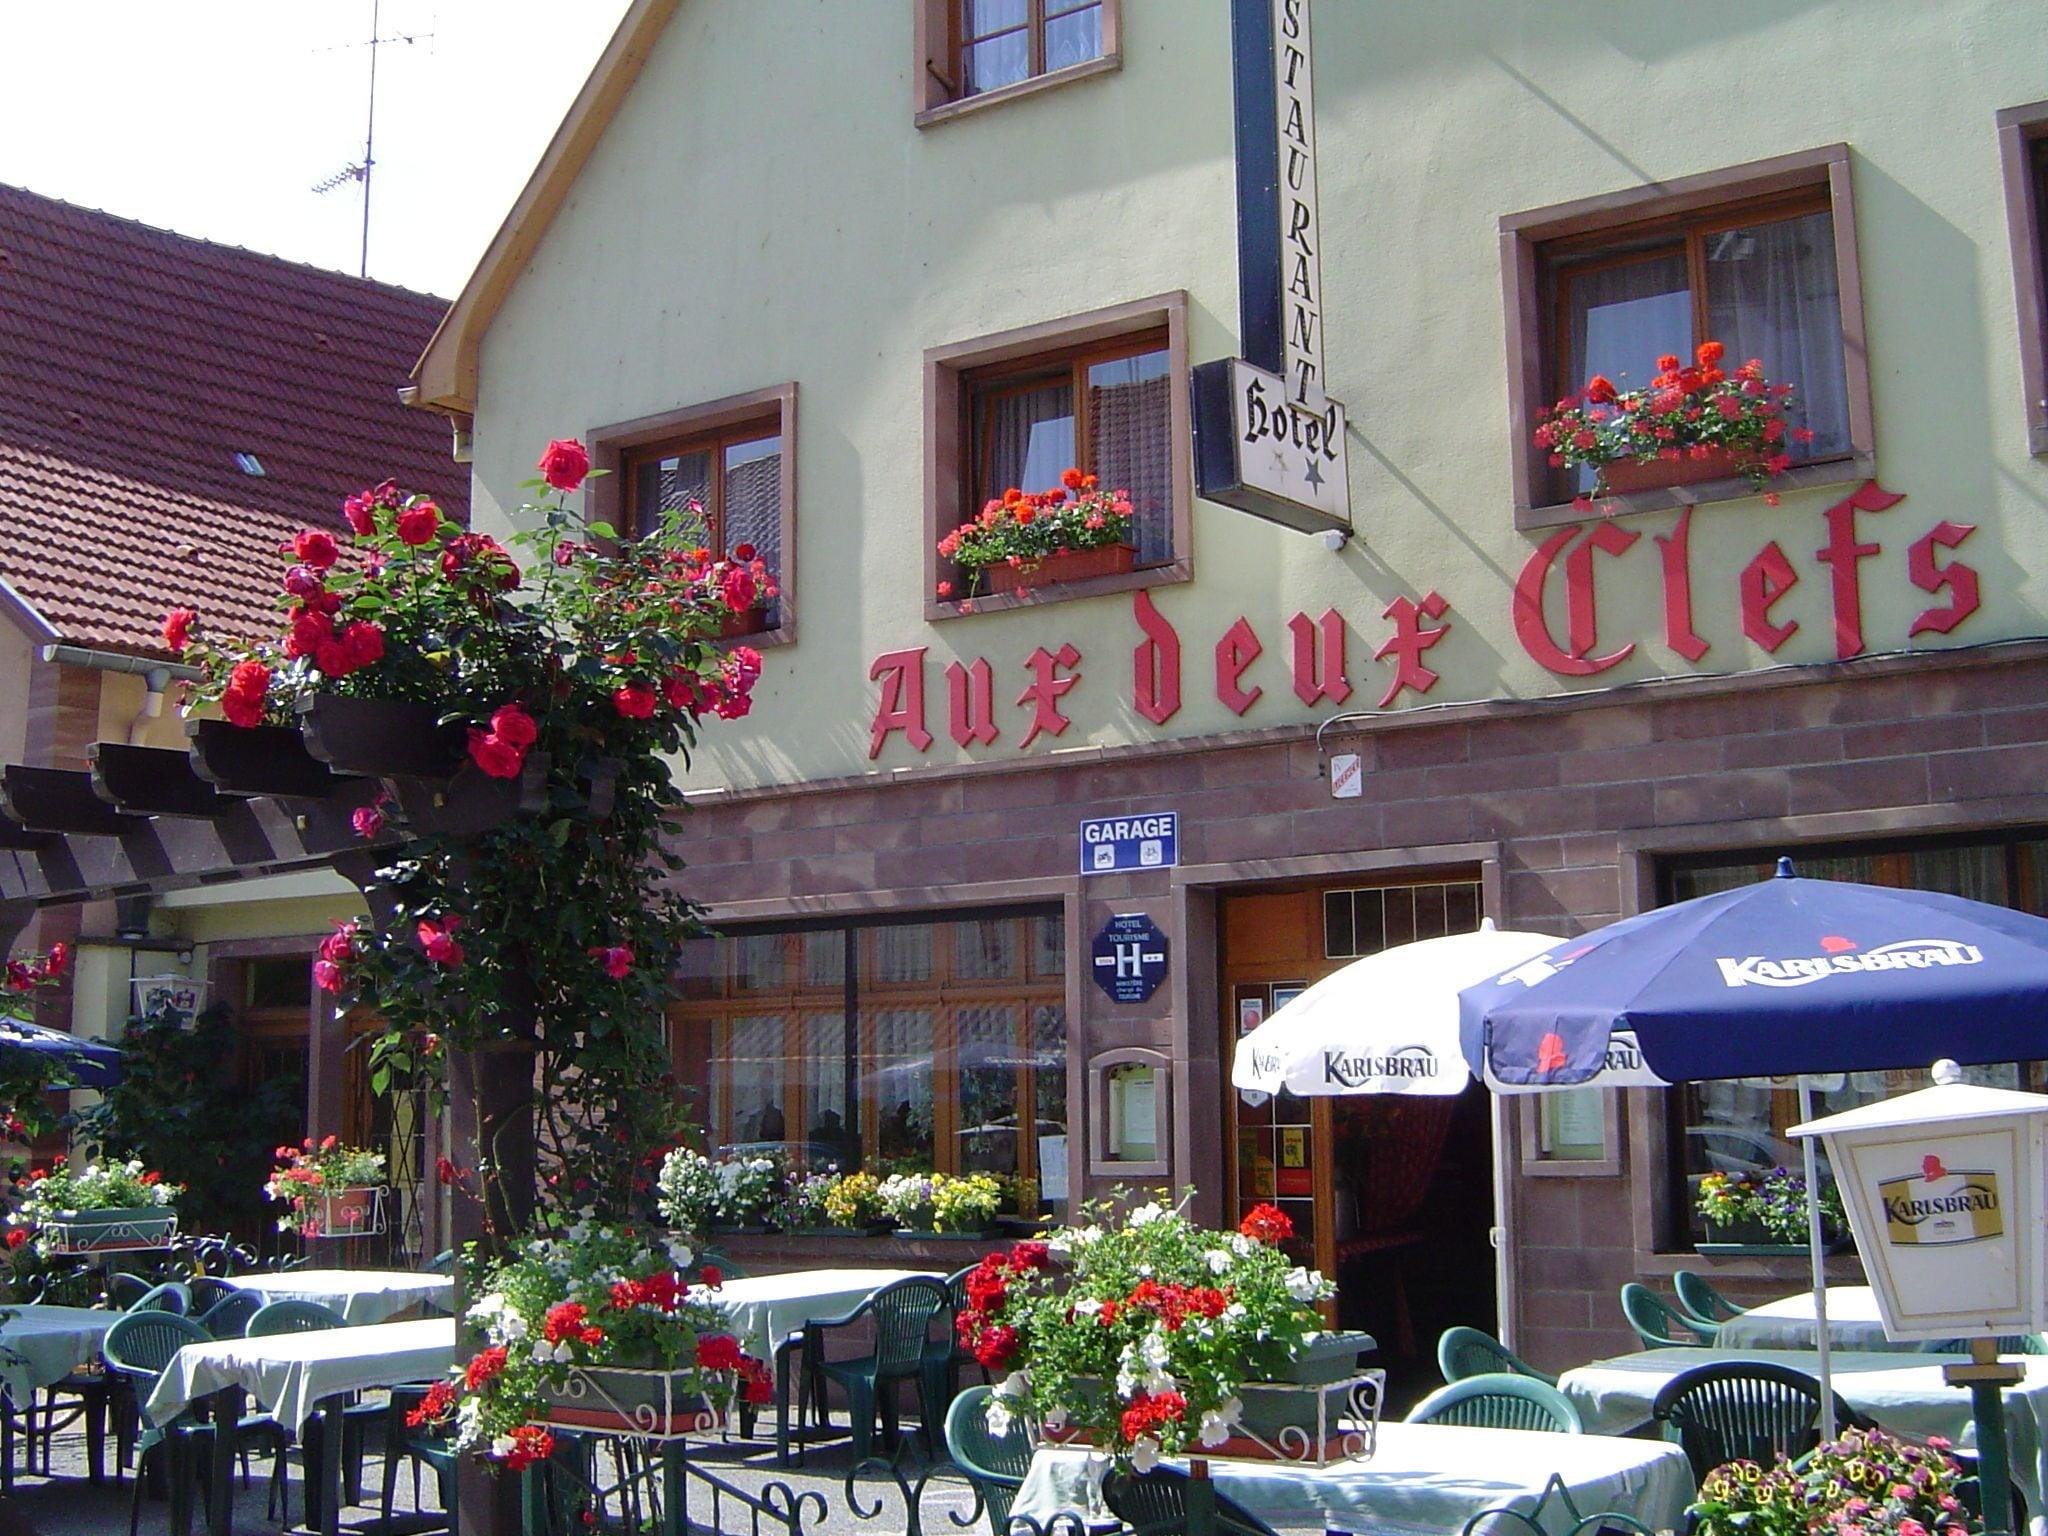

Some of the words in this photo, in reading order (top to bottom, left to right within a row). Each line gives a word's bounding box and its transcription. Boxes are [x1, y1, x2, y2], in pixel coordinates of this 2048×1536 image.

[869, 642, 1082, 760] Aux
[1133, 588, 1452, 726] deux
[1511, 478, 1982, 677] Clefs
[1085, 817, 1172, 843] GARAGE
[1116, 943, 1142, 977] H
